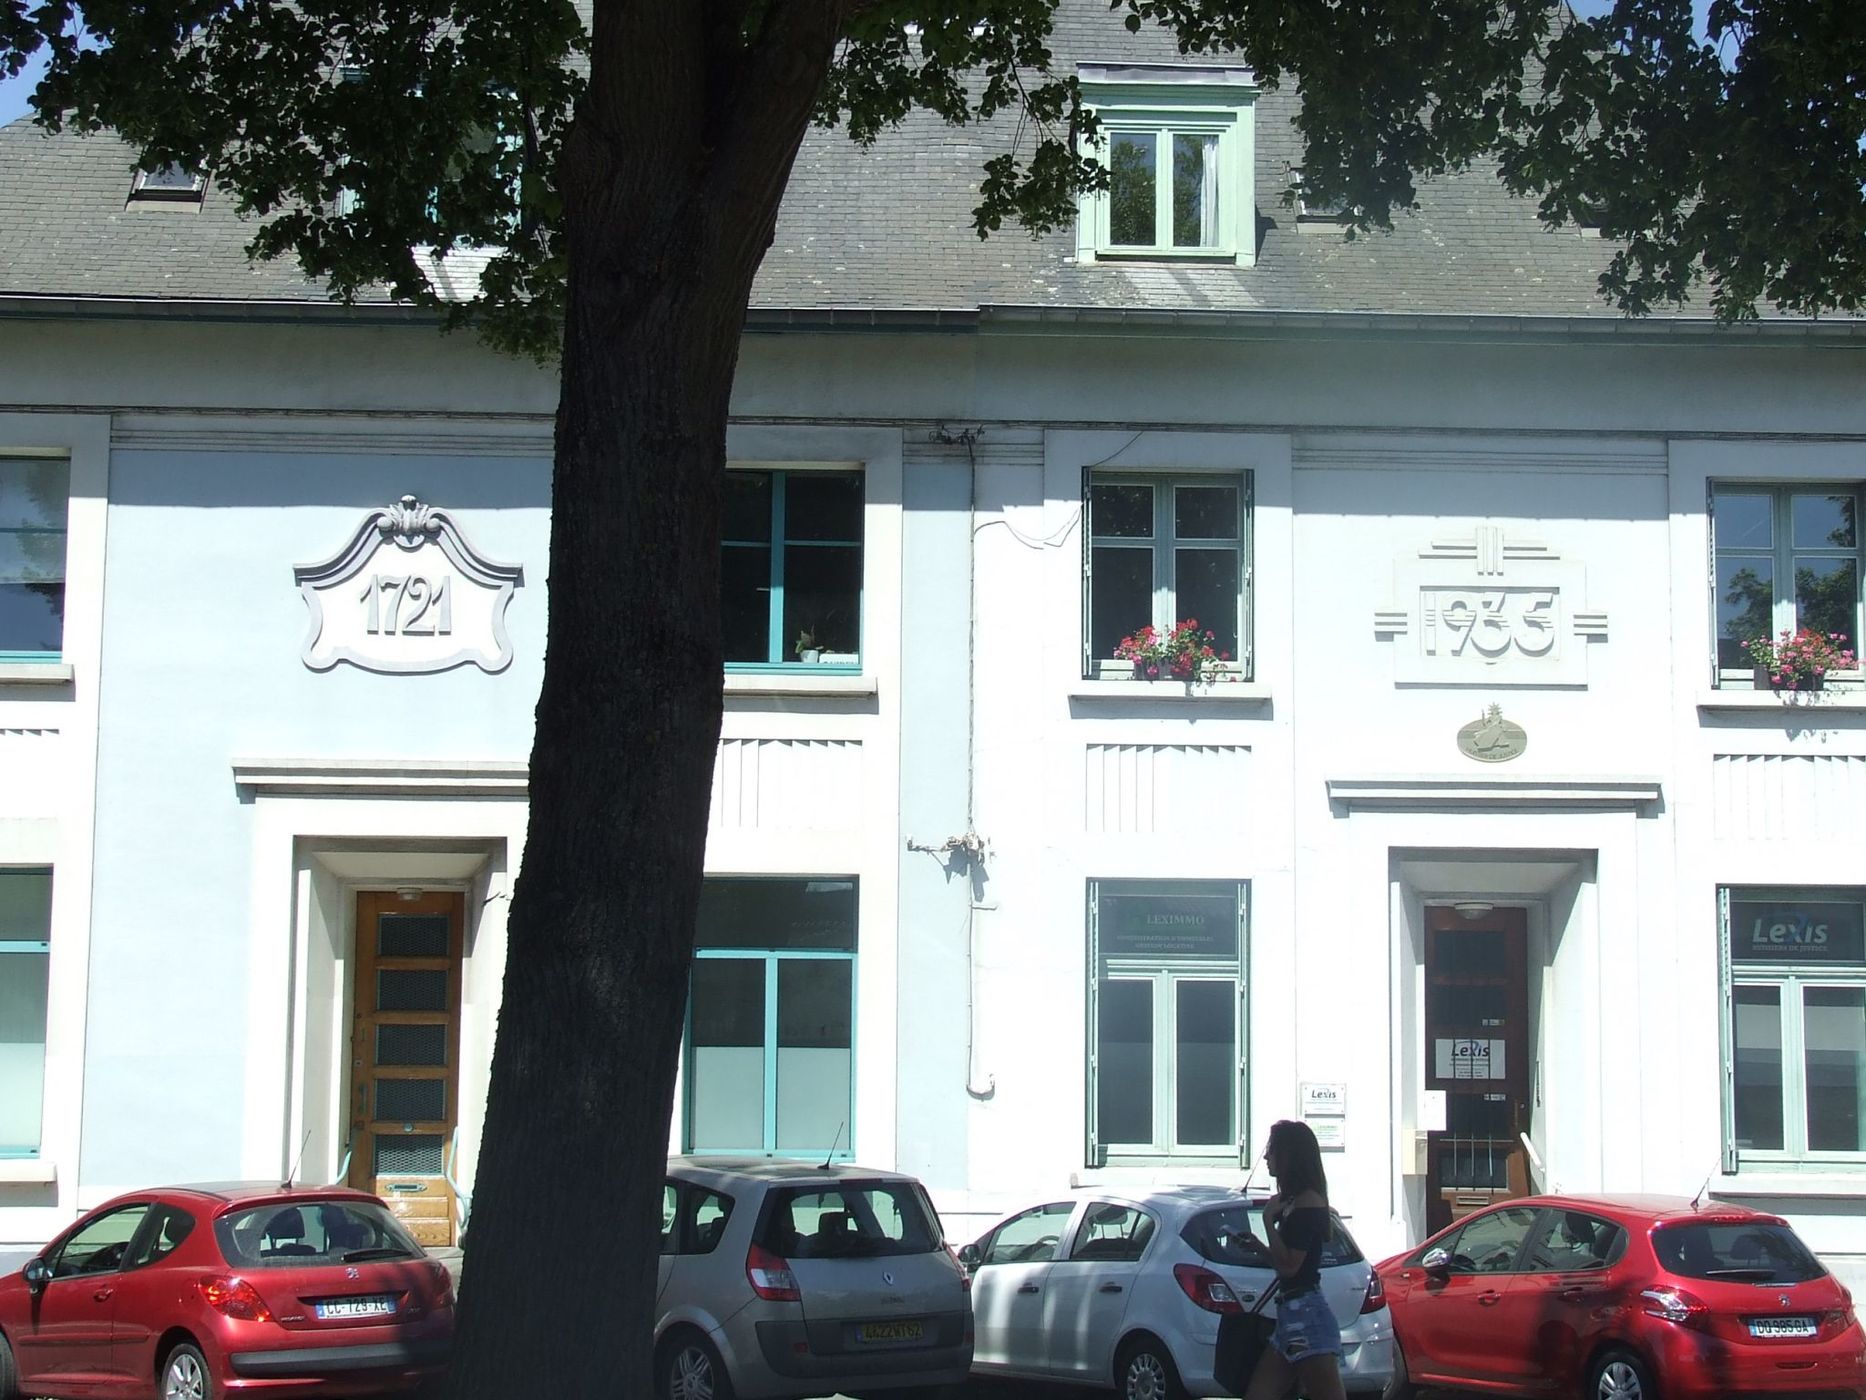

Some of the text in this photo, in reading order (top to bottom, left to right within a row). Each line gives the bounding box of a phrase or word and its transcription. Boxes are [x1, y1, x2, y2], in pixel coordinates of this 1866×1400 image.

[360, 574, 452, 637] 1721
[1423, 591, 1555, 659] 1935
[1146, 914, 1205, 926] LEXIMMO
[1752, 918, 1829, 943] Lexis
[1451, 1044, 1490, 1057] Lexis
[1311, 1089, 1337, 1099] Lexis
